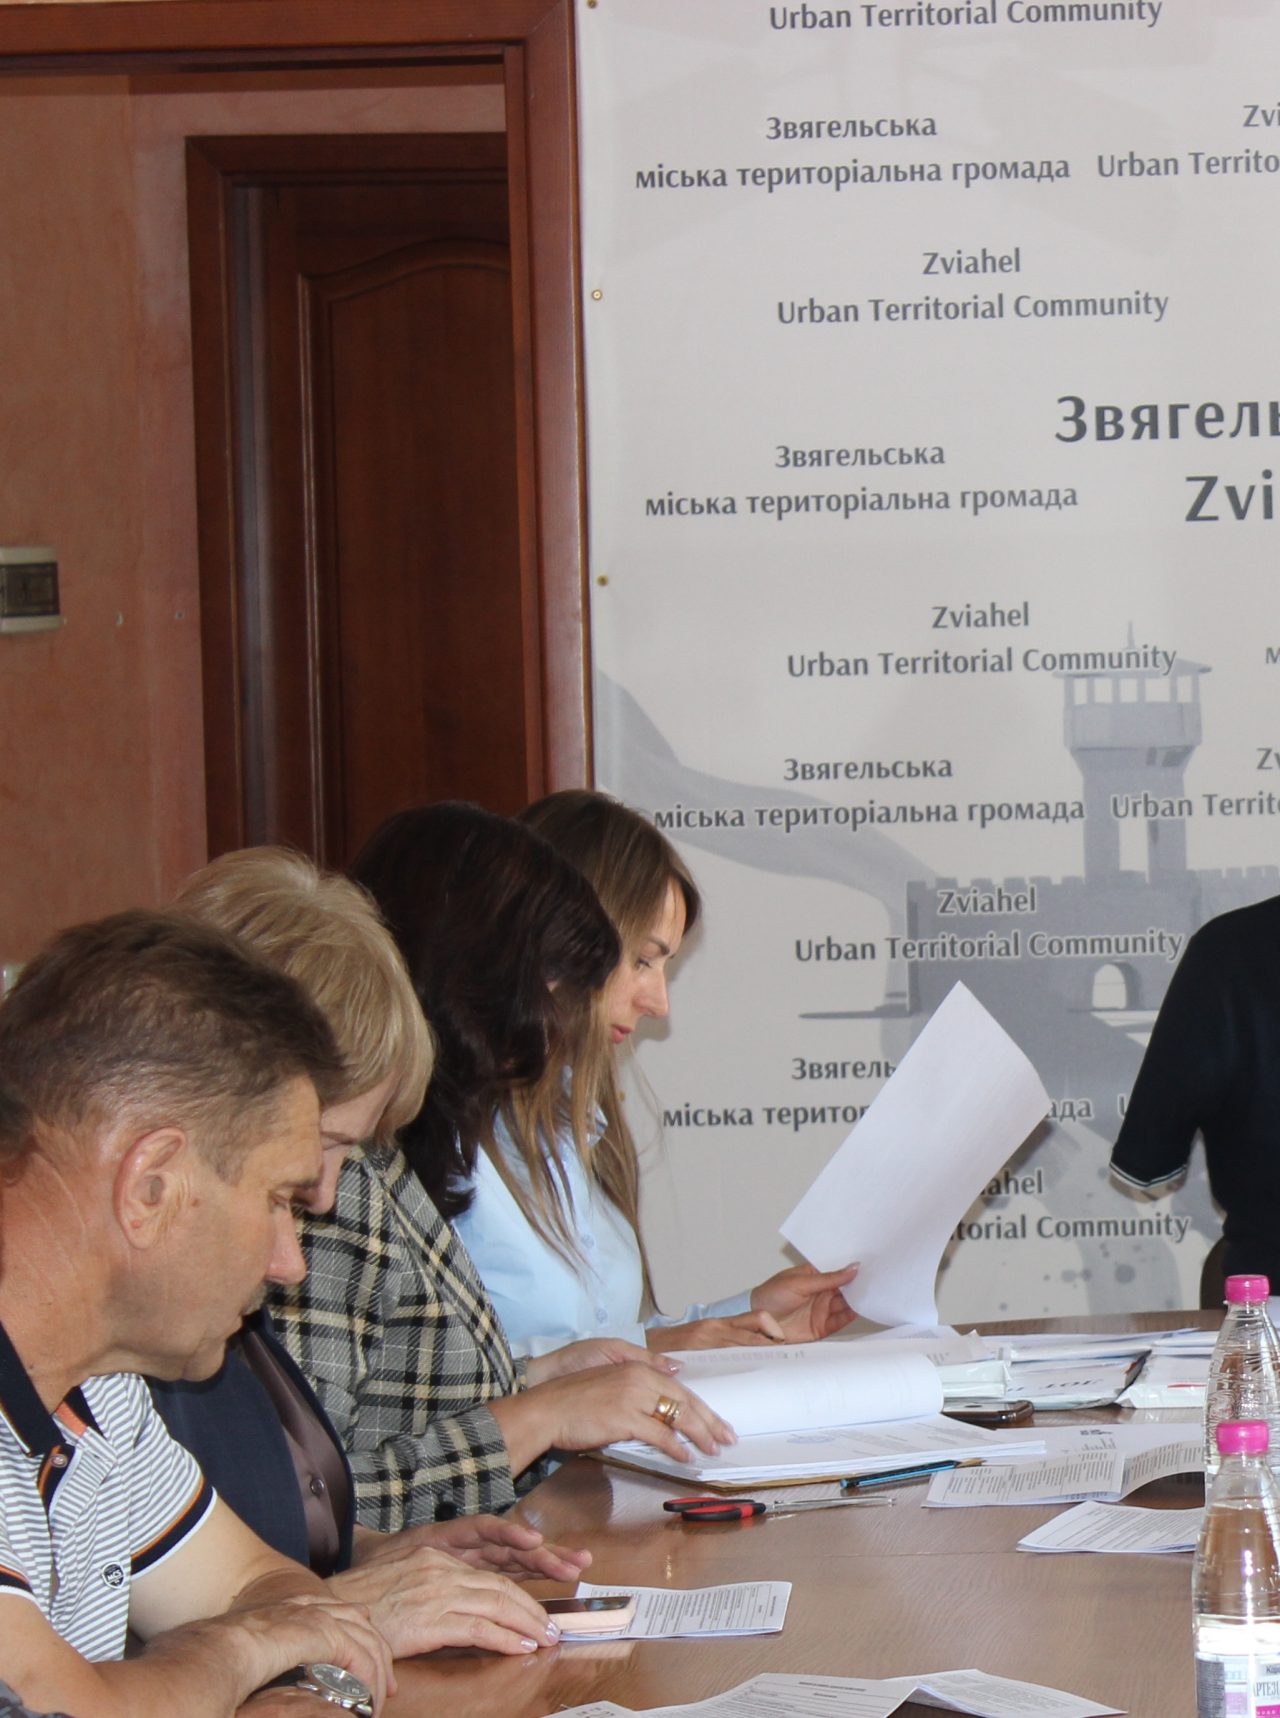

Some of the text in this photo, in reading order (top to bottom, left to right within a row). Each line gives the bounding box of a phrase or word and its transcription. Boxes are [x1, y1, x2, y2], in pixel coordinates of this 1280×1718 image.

[770, 0, 1162, 29] Urban Territorial Community
[767, 117, 937, 139] Звягельська
[637, 159, 1070, 193] міська територіальна громада
[1098, 151, 1178, 177] Urban
[923, 247, 1020, 274] Zviahel
[778, 290, 1168, 324] Urban Territorial Community
[776, 446, 944, 468] Звягельська
[646, 487, 1077, 520] міська територіальна громада
[933, 602, 1028, 628] Zviahel
[788, 645, 1176, 678] Urban Territorial Community
[784, 759, 952, 780] Звягельська
[655, 800, 1084, 833] міська територіальна громада
[1113, 793, 1192, 818] Urban
[937, 888, 1036, 914] Zviahel
[796, 929, 1184, 961] Urban Territorial Community
[664, 1103, 753, 1126] міська
[981, 1169, 1042, 1195] ahel
[951, 1212, 1188, 1243] torial Community
